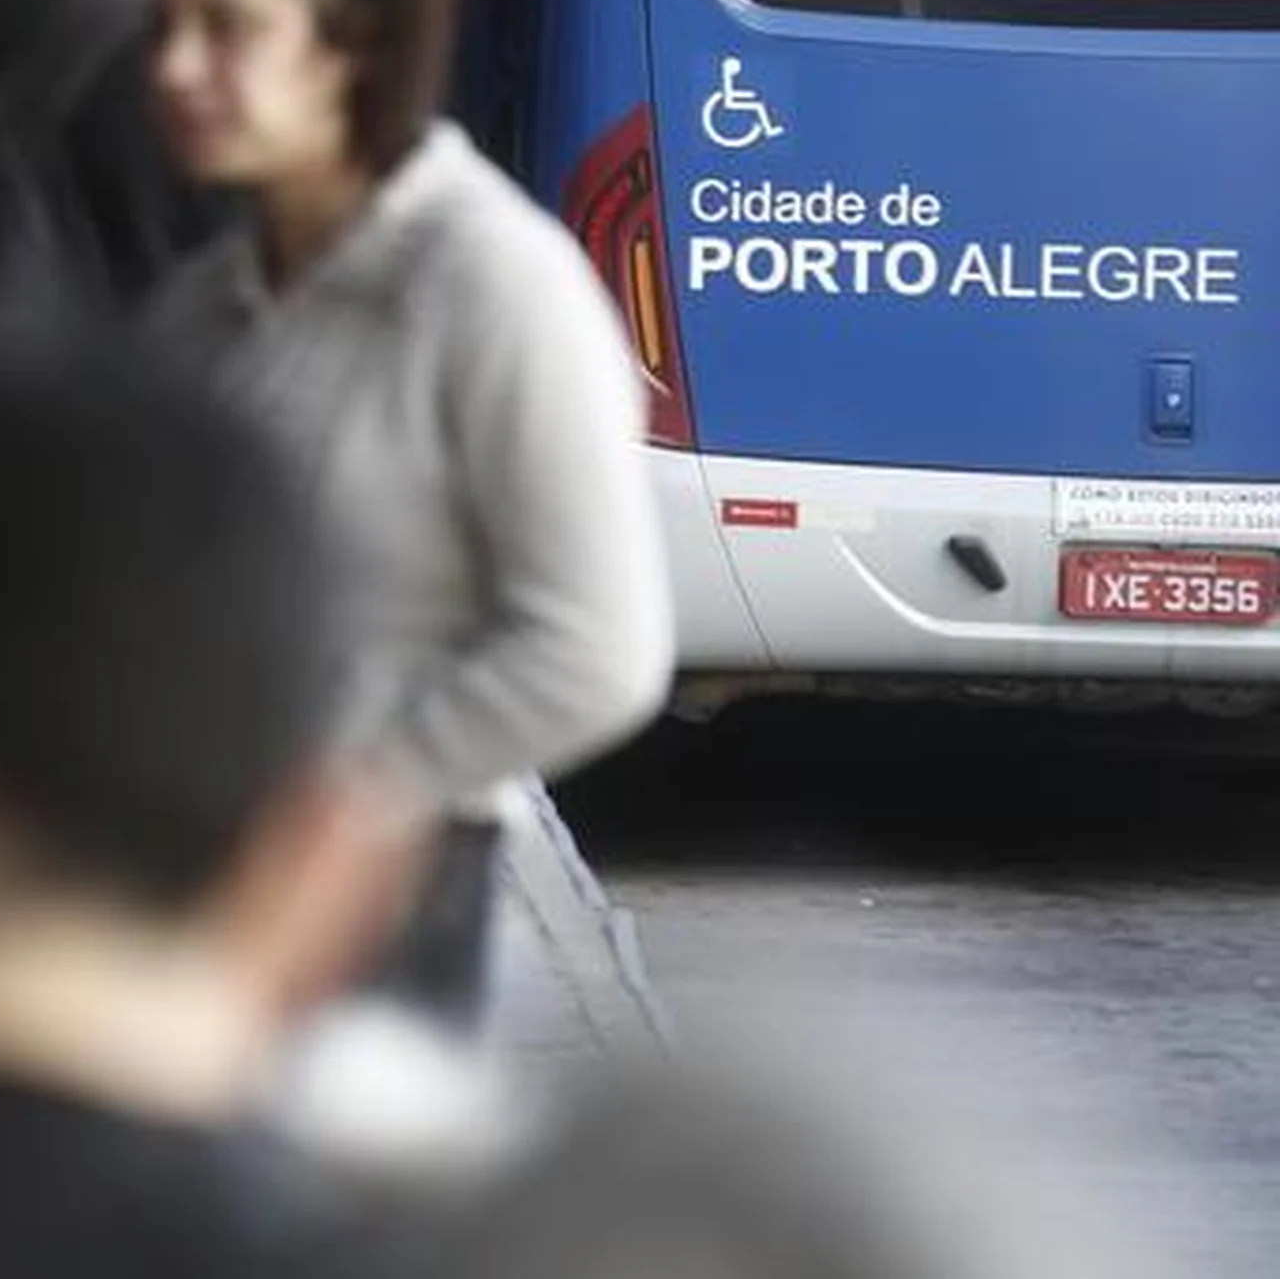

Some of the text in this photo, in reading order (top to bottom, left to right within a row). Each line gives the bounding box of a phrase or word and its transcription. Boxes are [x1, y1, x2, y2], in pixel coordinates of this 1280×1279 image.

[691, 179, 940, 227] Cidade de
[689, 237, 1240, 303] PORTO ALEGRE
